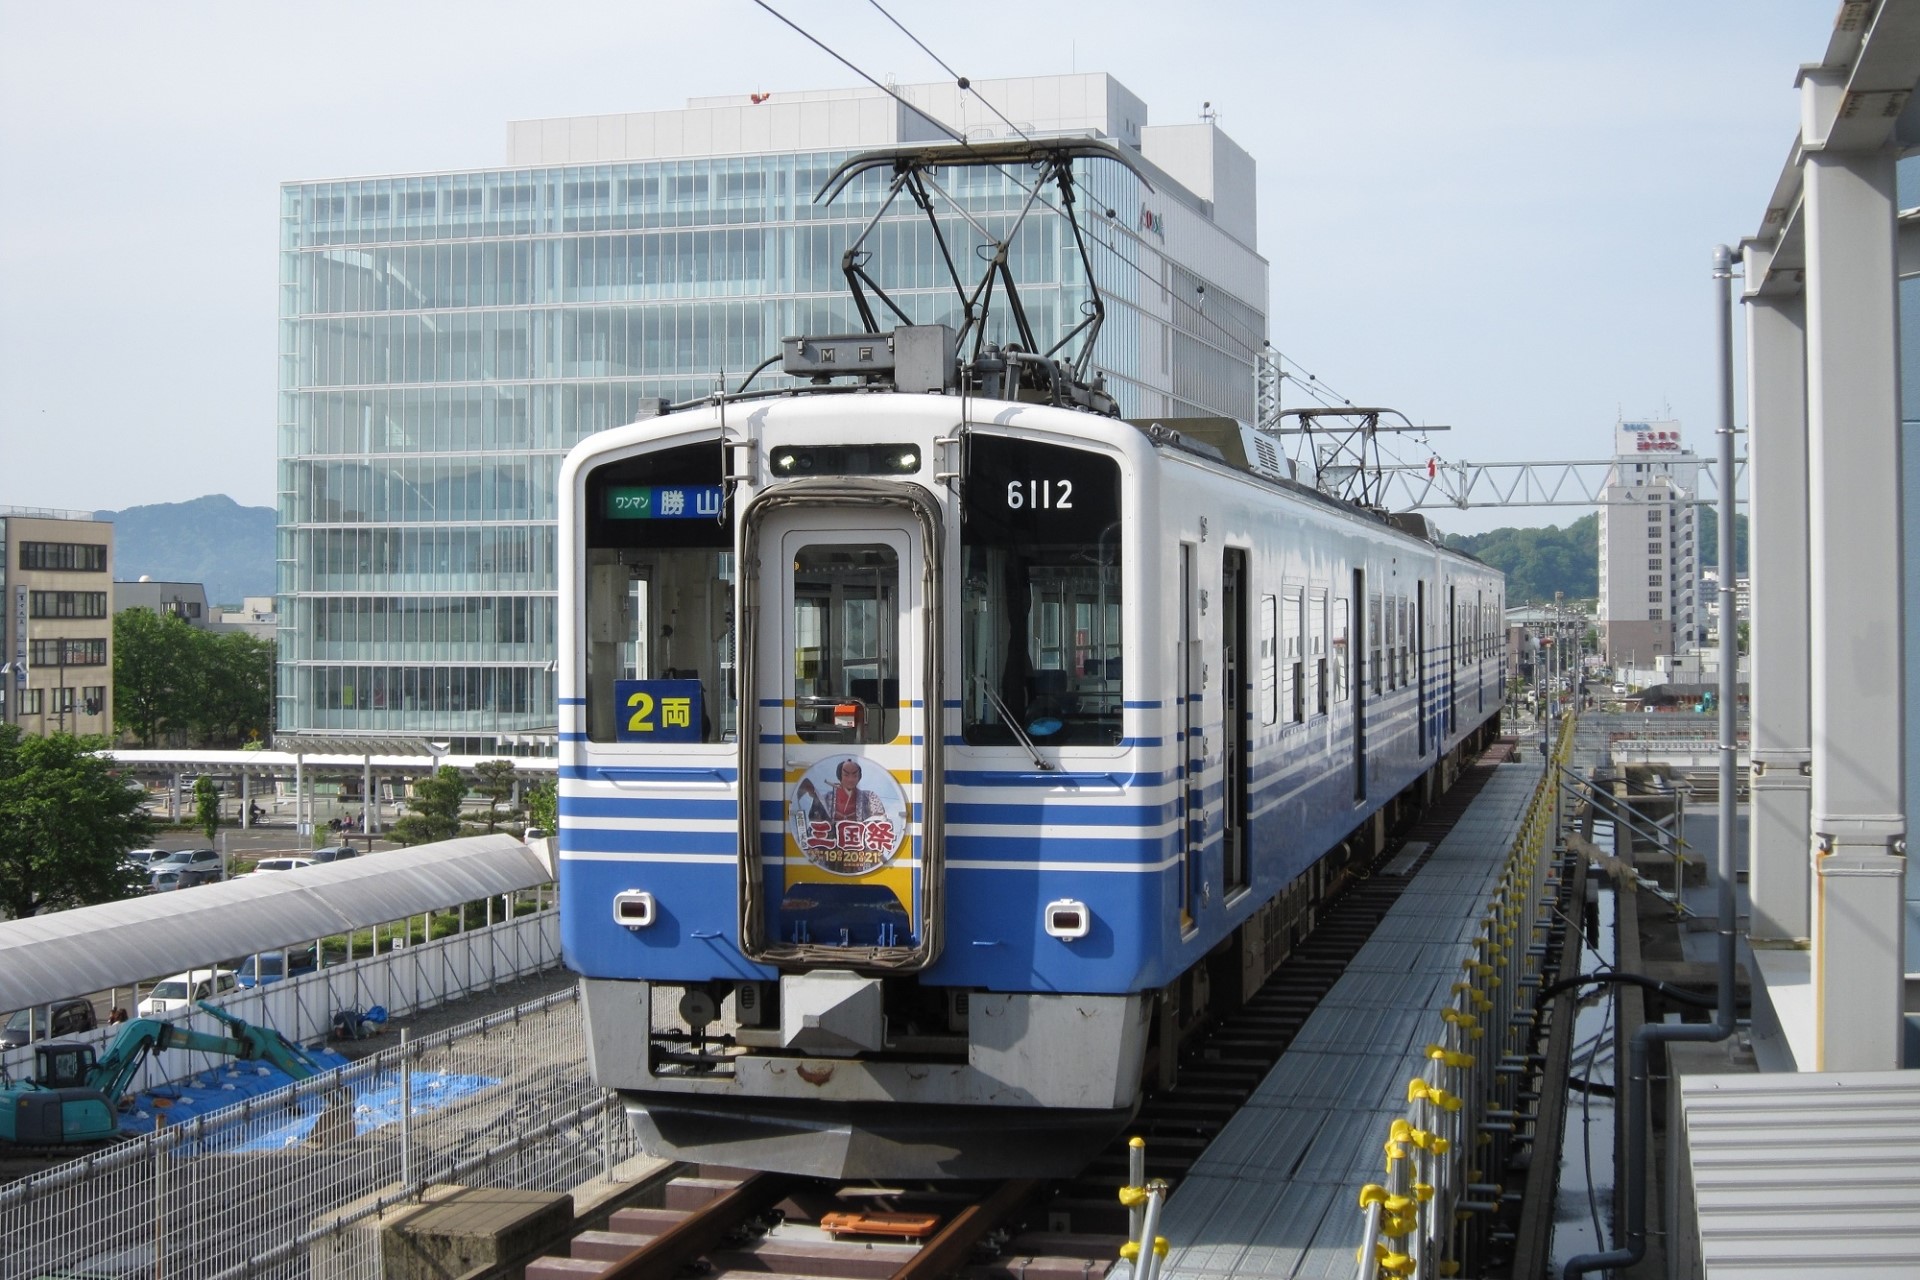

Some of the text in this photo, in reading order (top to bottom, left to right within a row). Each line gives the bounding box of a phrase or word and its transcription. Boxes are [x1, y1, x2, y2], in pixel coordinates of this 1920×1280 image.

[822, 348, 871, 361] M F
[615, 496, 649, 509] ワンマン
[660, 490, 719, 515] 勝山
[1007, 479, 1073, 509] 6112
[627, 692, 691, 731] 2両
[807, 821, 894, 851] 三国祭
